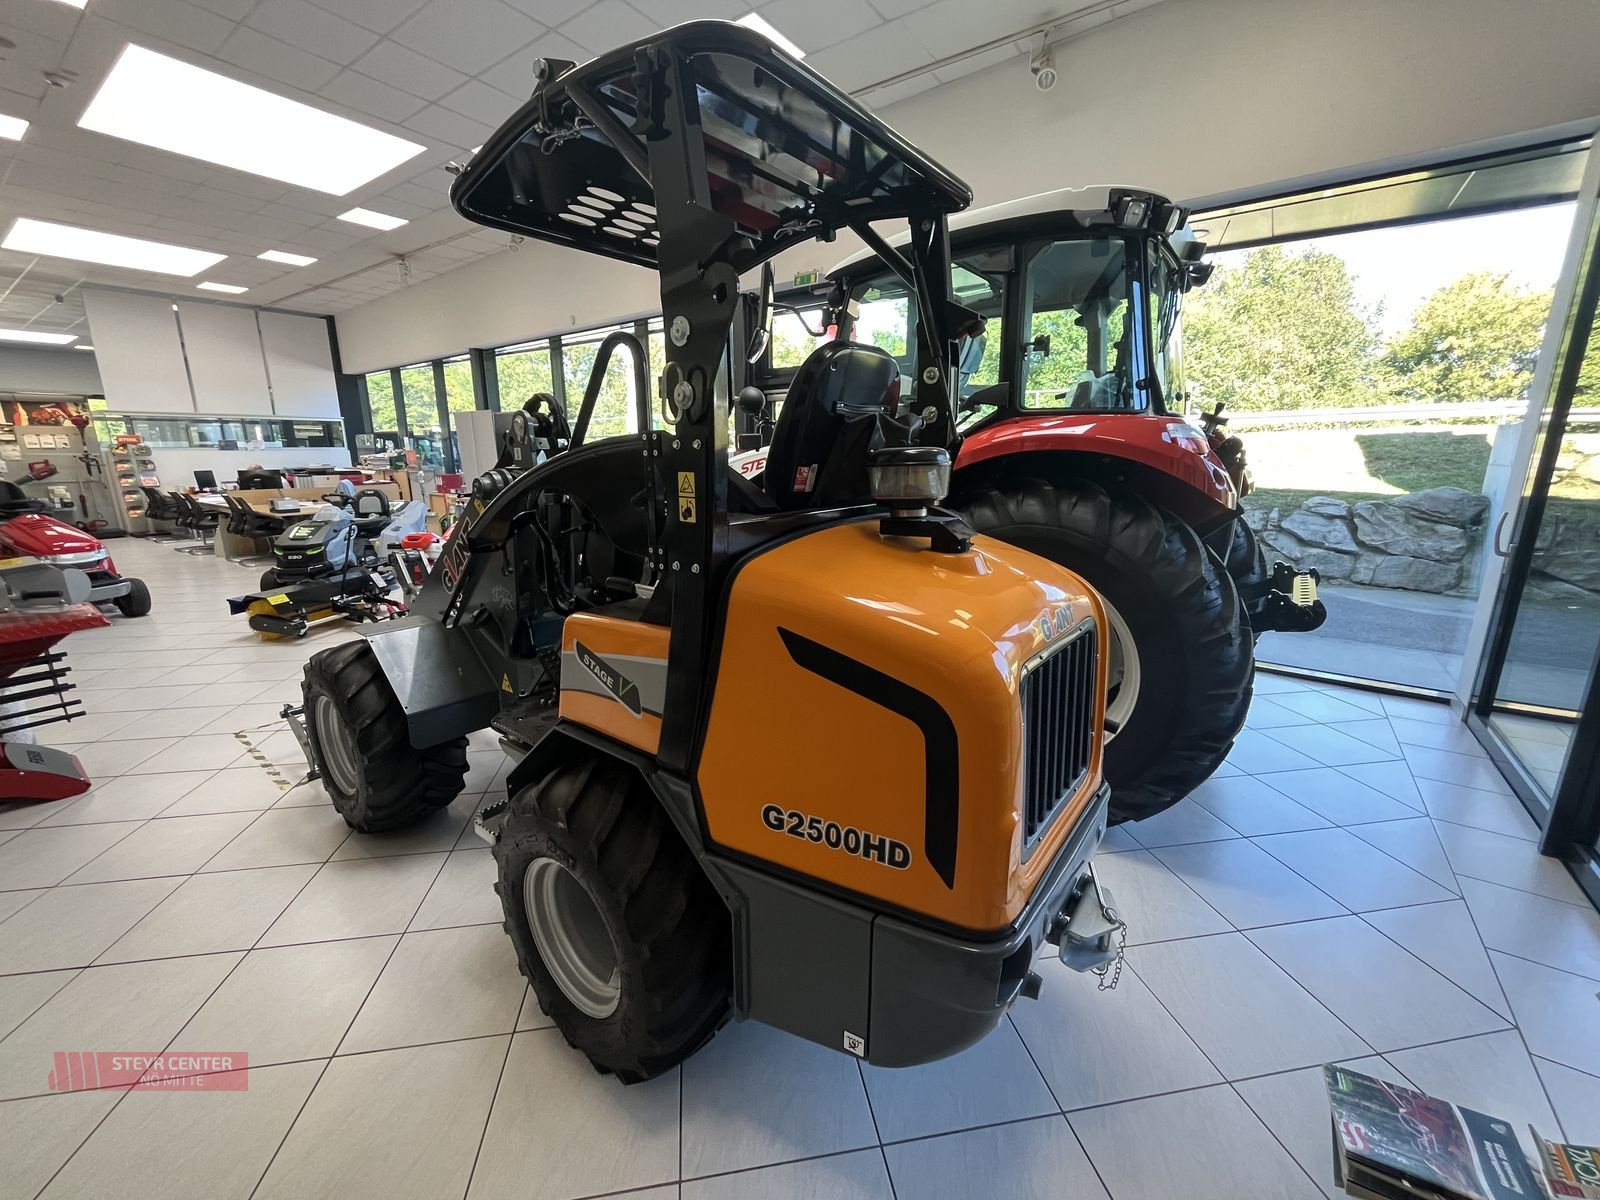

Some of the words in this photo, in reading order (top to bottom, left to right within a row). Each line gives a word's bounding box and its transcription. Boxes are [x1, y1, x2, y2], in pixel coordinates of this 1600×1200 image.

[741, 457, 766, 475] STE
[583, 653, 615, 689] STAGE
[761, 803, 913, 871] G2500HD
